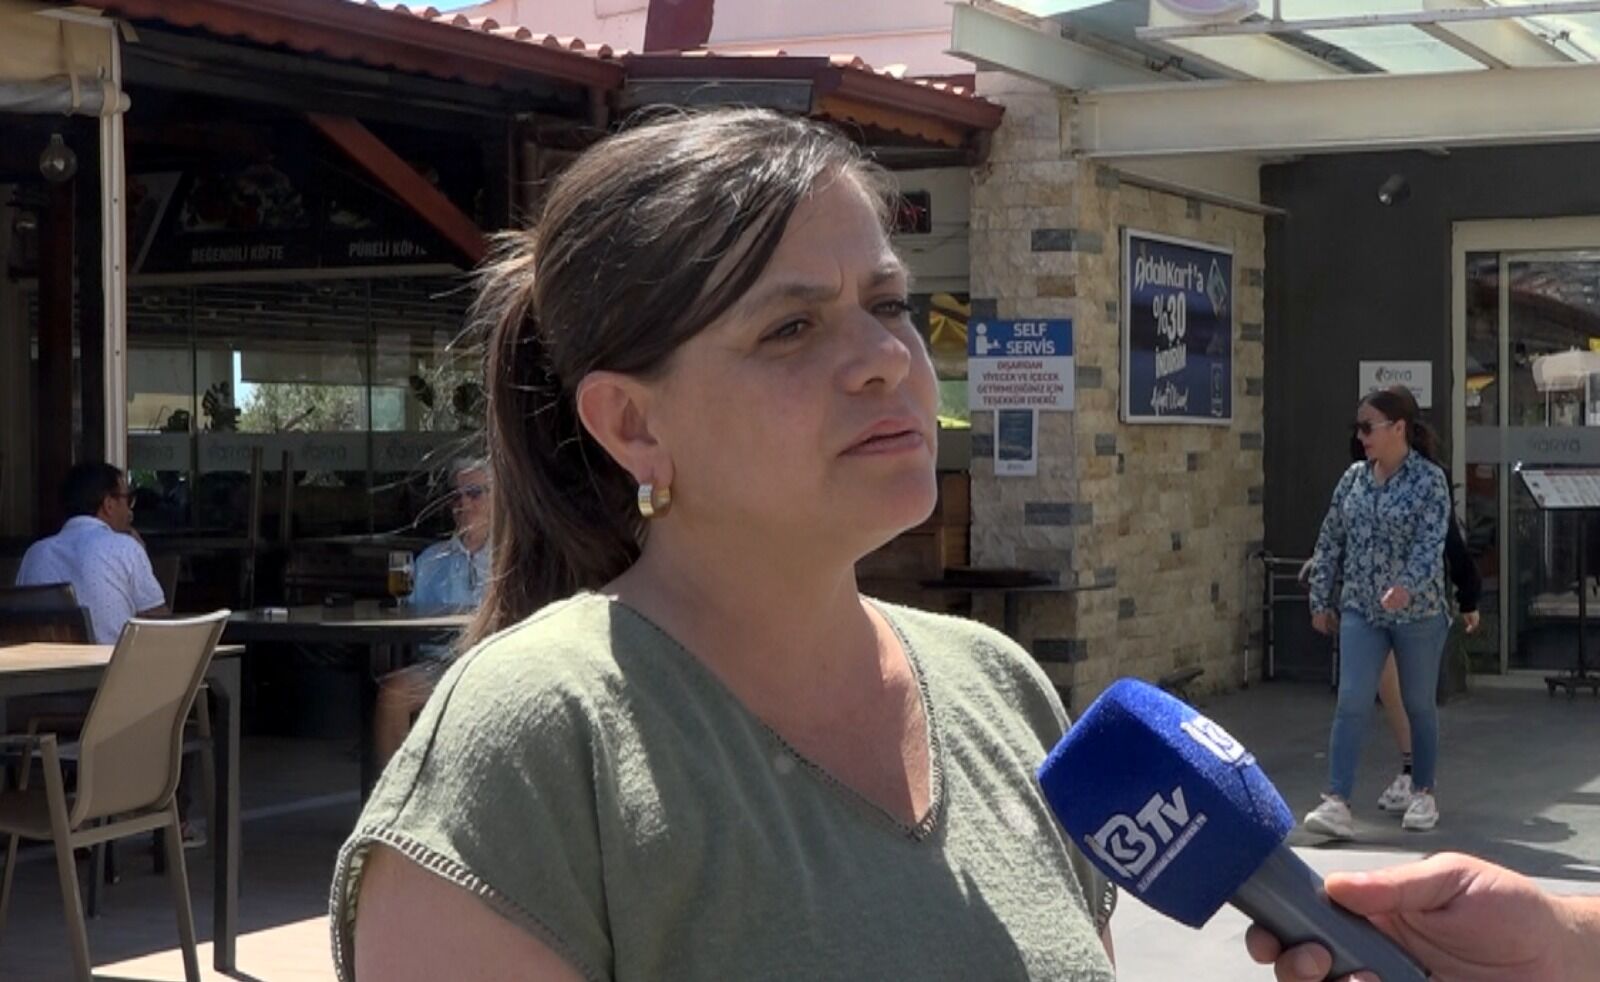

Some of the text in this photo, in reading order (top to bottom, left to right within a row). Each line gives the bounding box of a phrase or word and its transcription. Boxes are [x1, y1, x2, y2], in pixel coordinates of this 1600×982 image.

[1152, 291, 1187, 341] %30
[1013, 322, 1048, 337] SELF
[1005, 338, 1056, 354] SERVİS
[1017, 372, 1028, 381] VE
